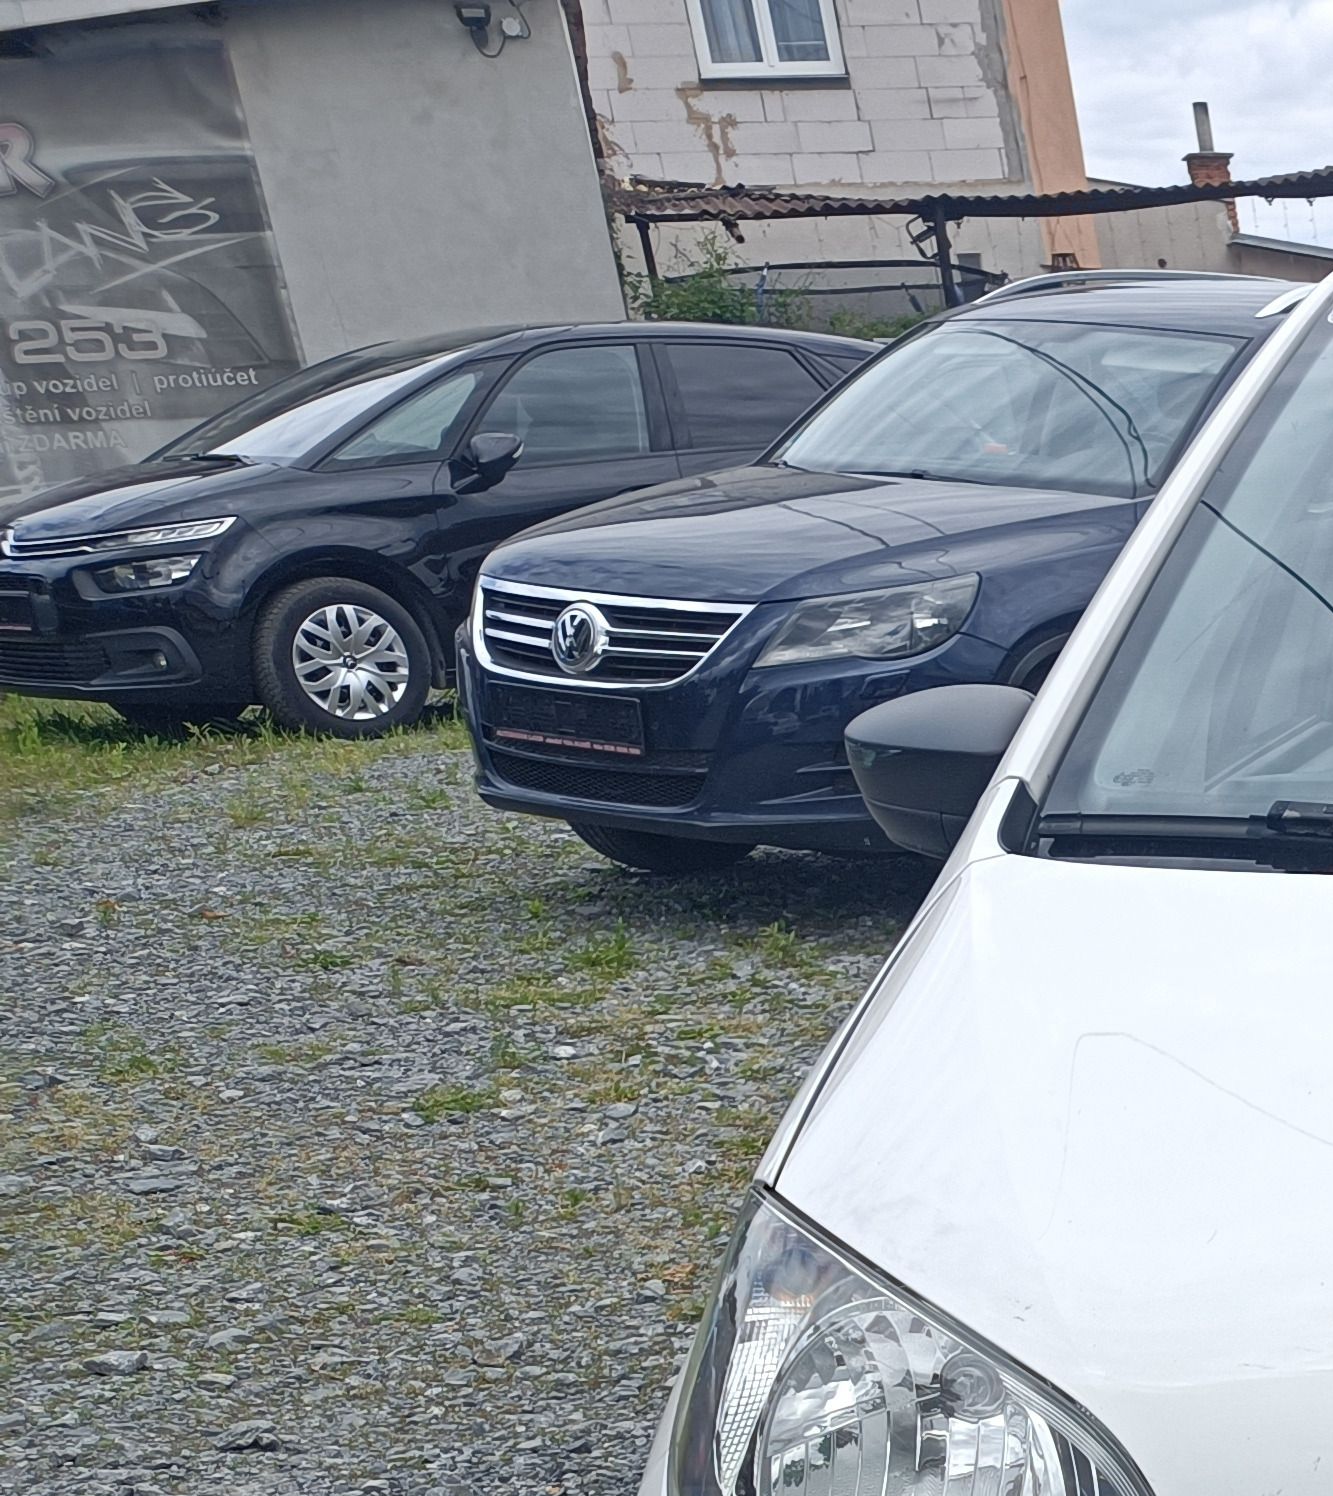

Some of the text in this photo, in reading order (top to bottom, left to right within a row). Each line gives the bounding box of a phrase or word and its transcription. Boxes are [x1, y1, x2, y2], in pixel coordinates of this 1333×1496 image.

[33, 373, 119, 394] vozidel
[153, 368, 259, 392] protiúčet
[66, 402, 152, 422] vozidel
[19, 430, 126, 453] ZDARMA
